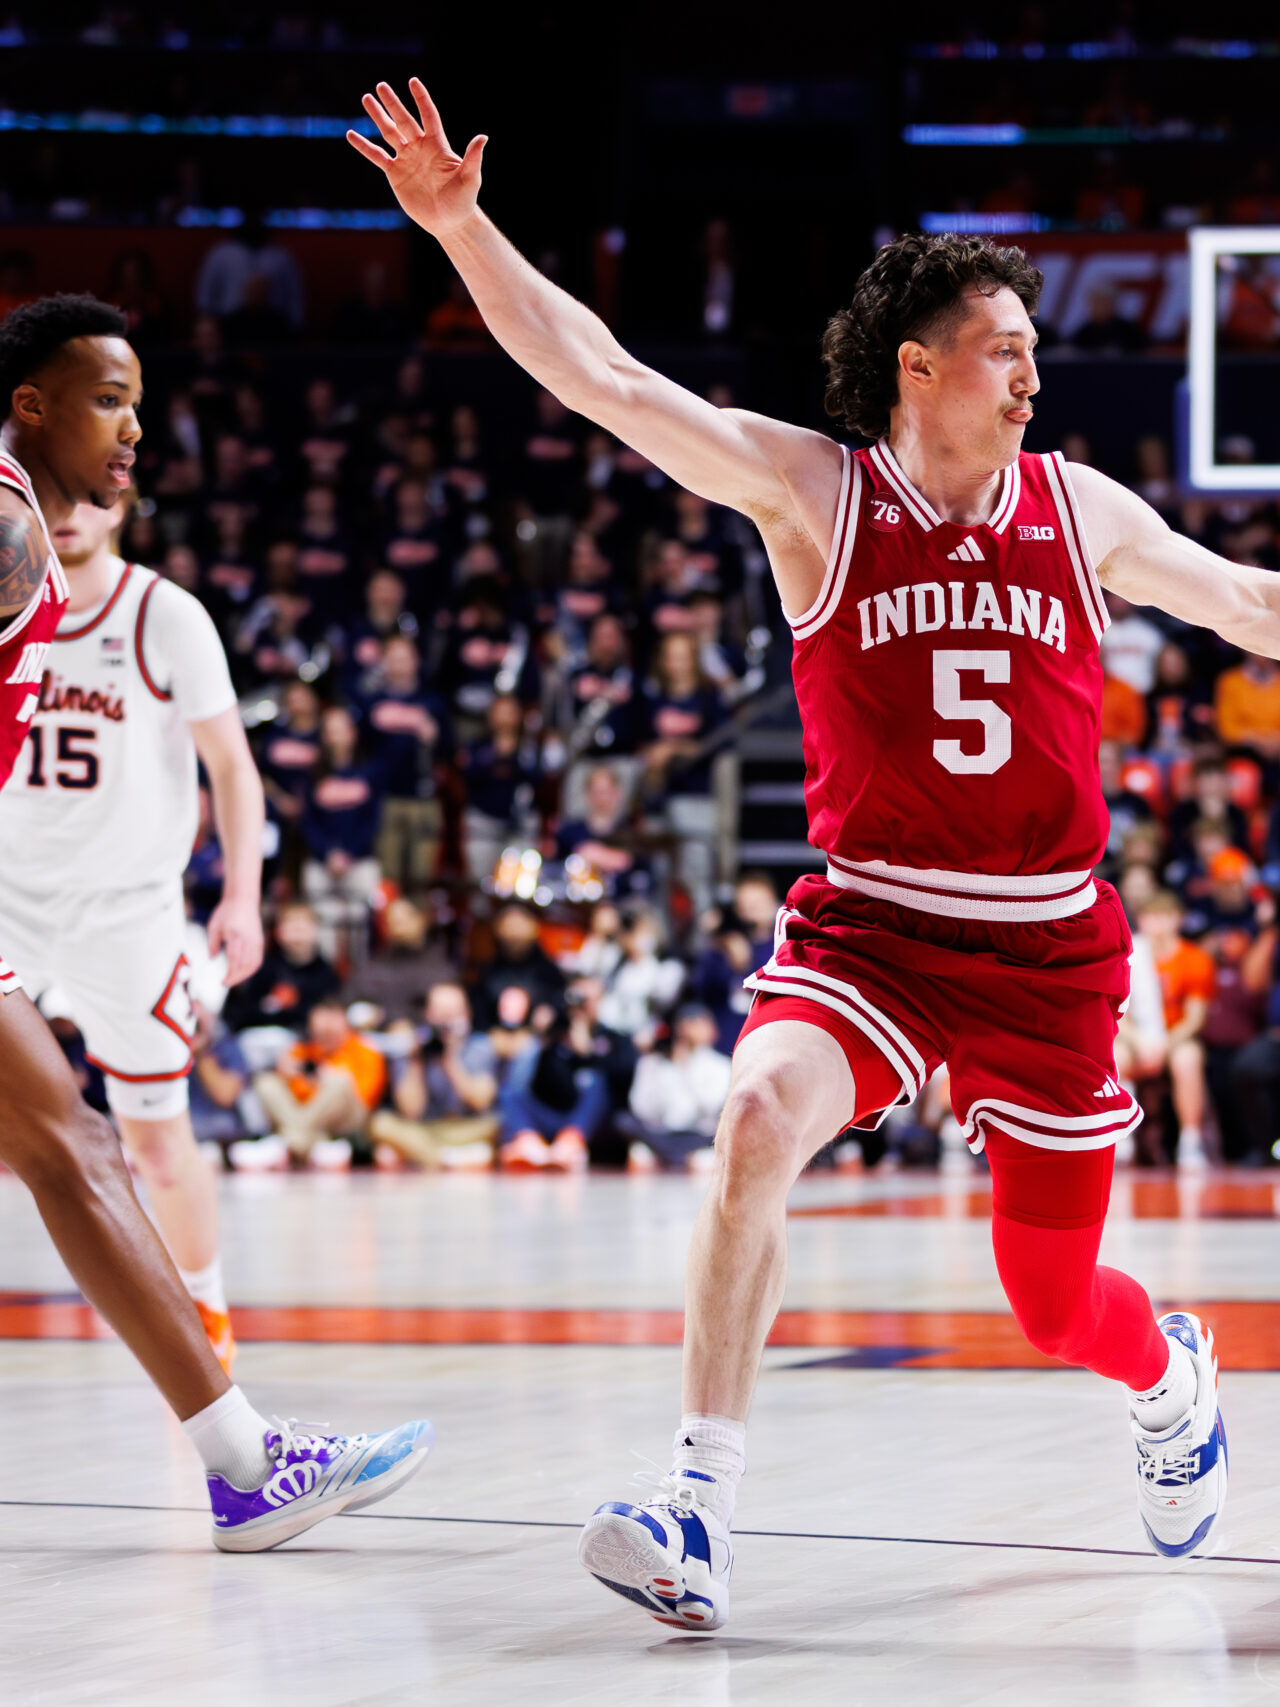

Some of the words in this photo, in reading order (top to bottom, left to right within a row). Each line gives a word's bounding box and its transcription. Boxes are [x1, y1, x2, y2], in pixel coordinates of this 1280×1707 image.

[857, 581, 1067, 655] INDIANA
[36, 668, 126, 722] linois
[932, 649, 1012, 775] 5
[27, 725, 99, 791] 15
